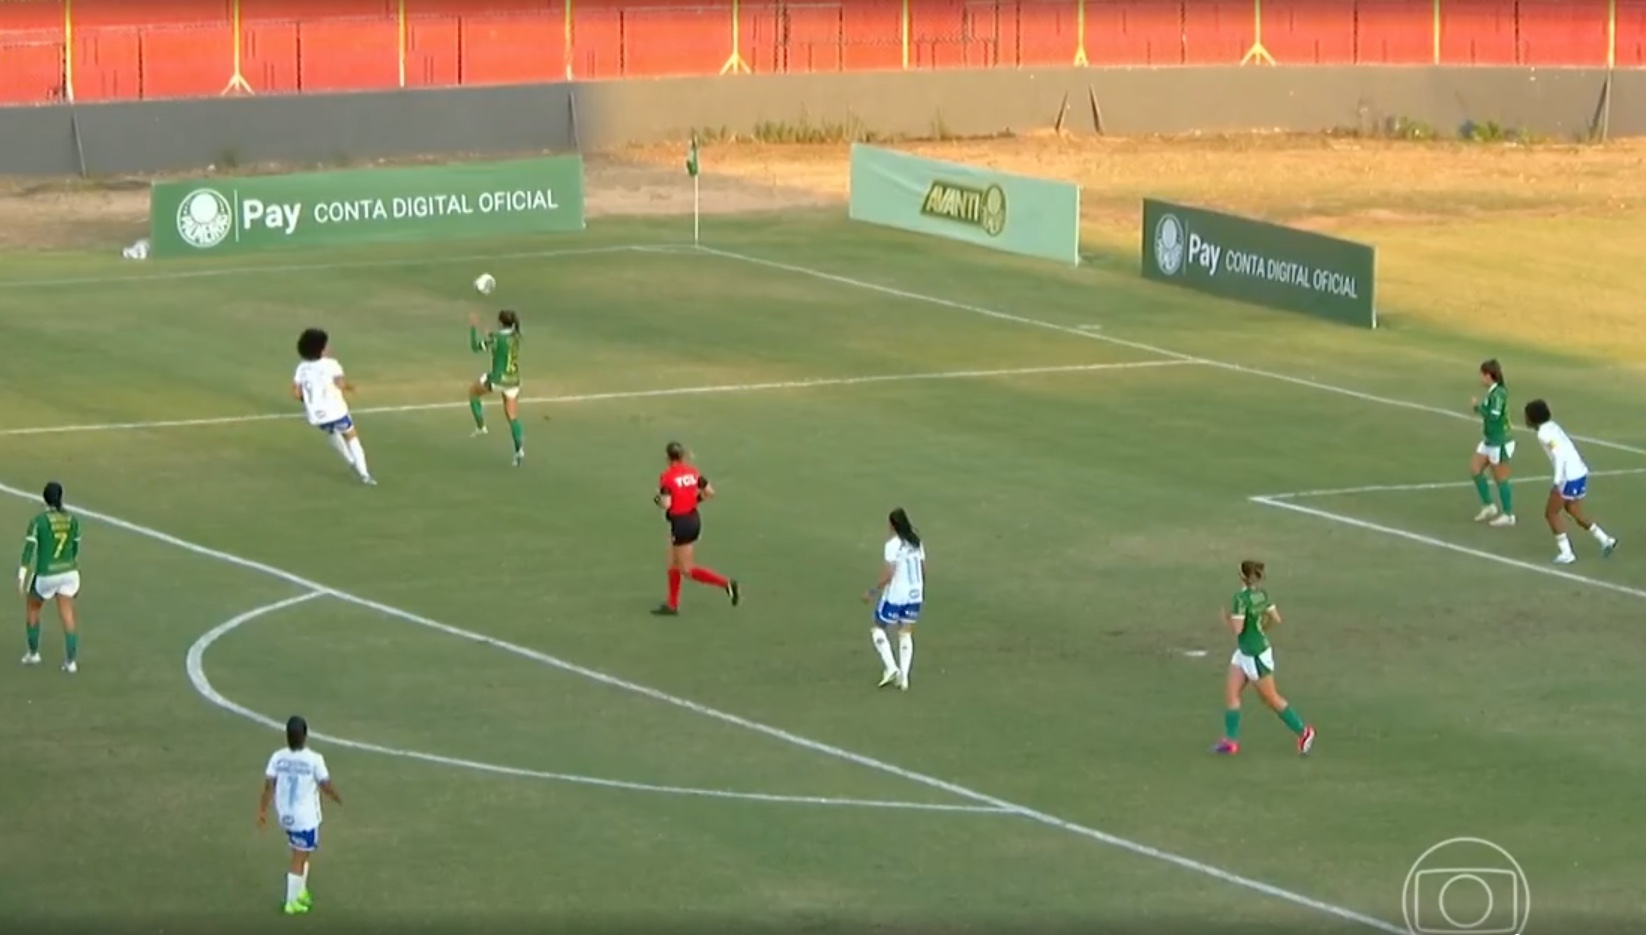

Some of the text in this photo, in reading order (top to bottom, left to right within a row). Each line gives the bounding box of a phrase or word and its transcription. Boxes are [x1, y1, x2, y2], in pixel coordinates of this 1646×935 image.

[243, 188, 559, 235] Pay CONTA DIGITAL OFICIAL
[925, 184, 981, 222] AVANTI
[1188, 233, 1221, 276] Pay
[1225, 250, 1265, 278] CONTA
[1267, 258, 1311, 289] DIGITAL
[1312, 268, 1358, 299] OFICIAL
[675, 474, 698, 488] TCL
[53, 532, 68, 558] 7
[905, 556, 920, 584] 11
[287, 775, 299, 808] 7
